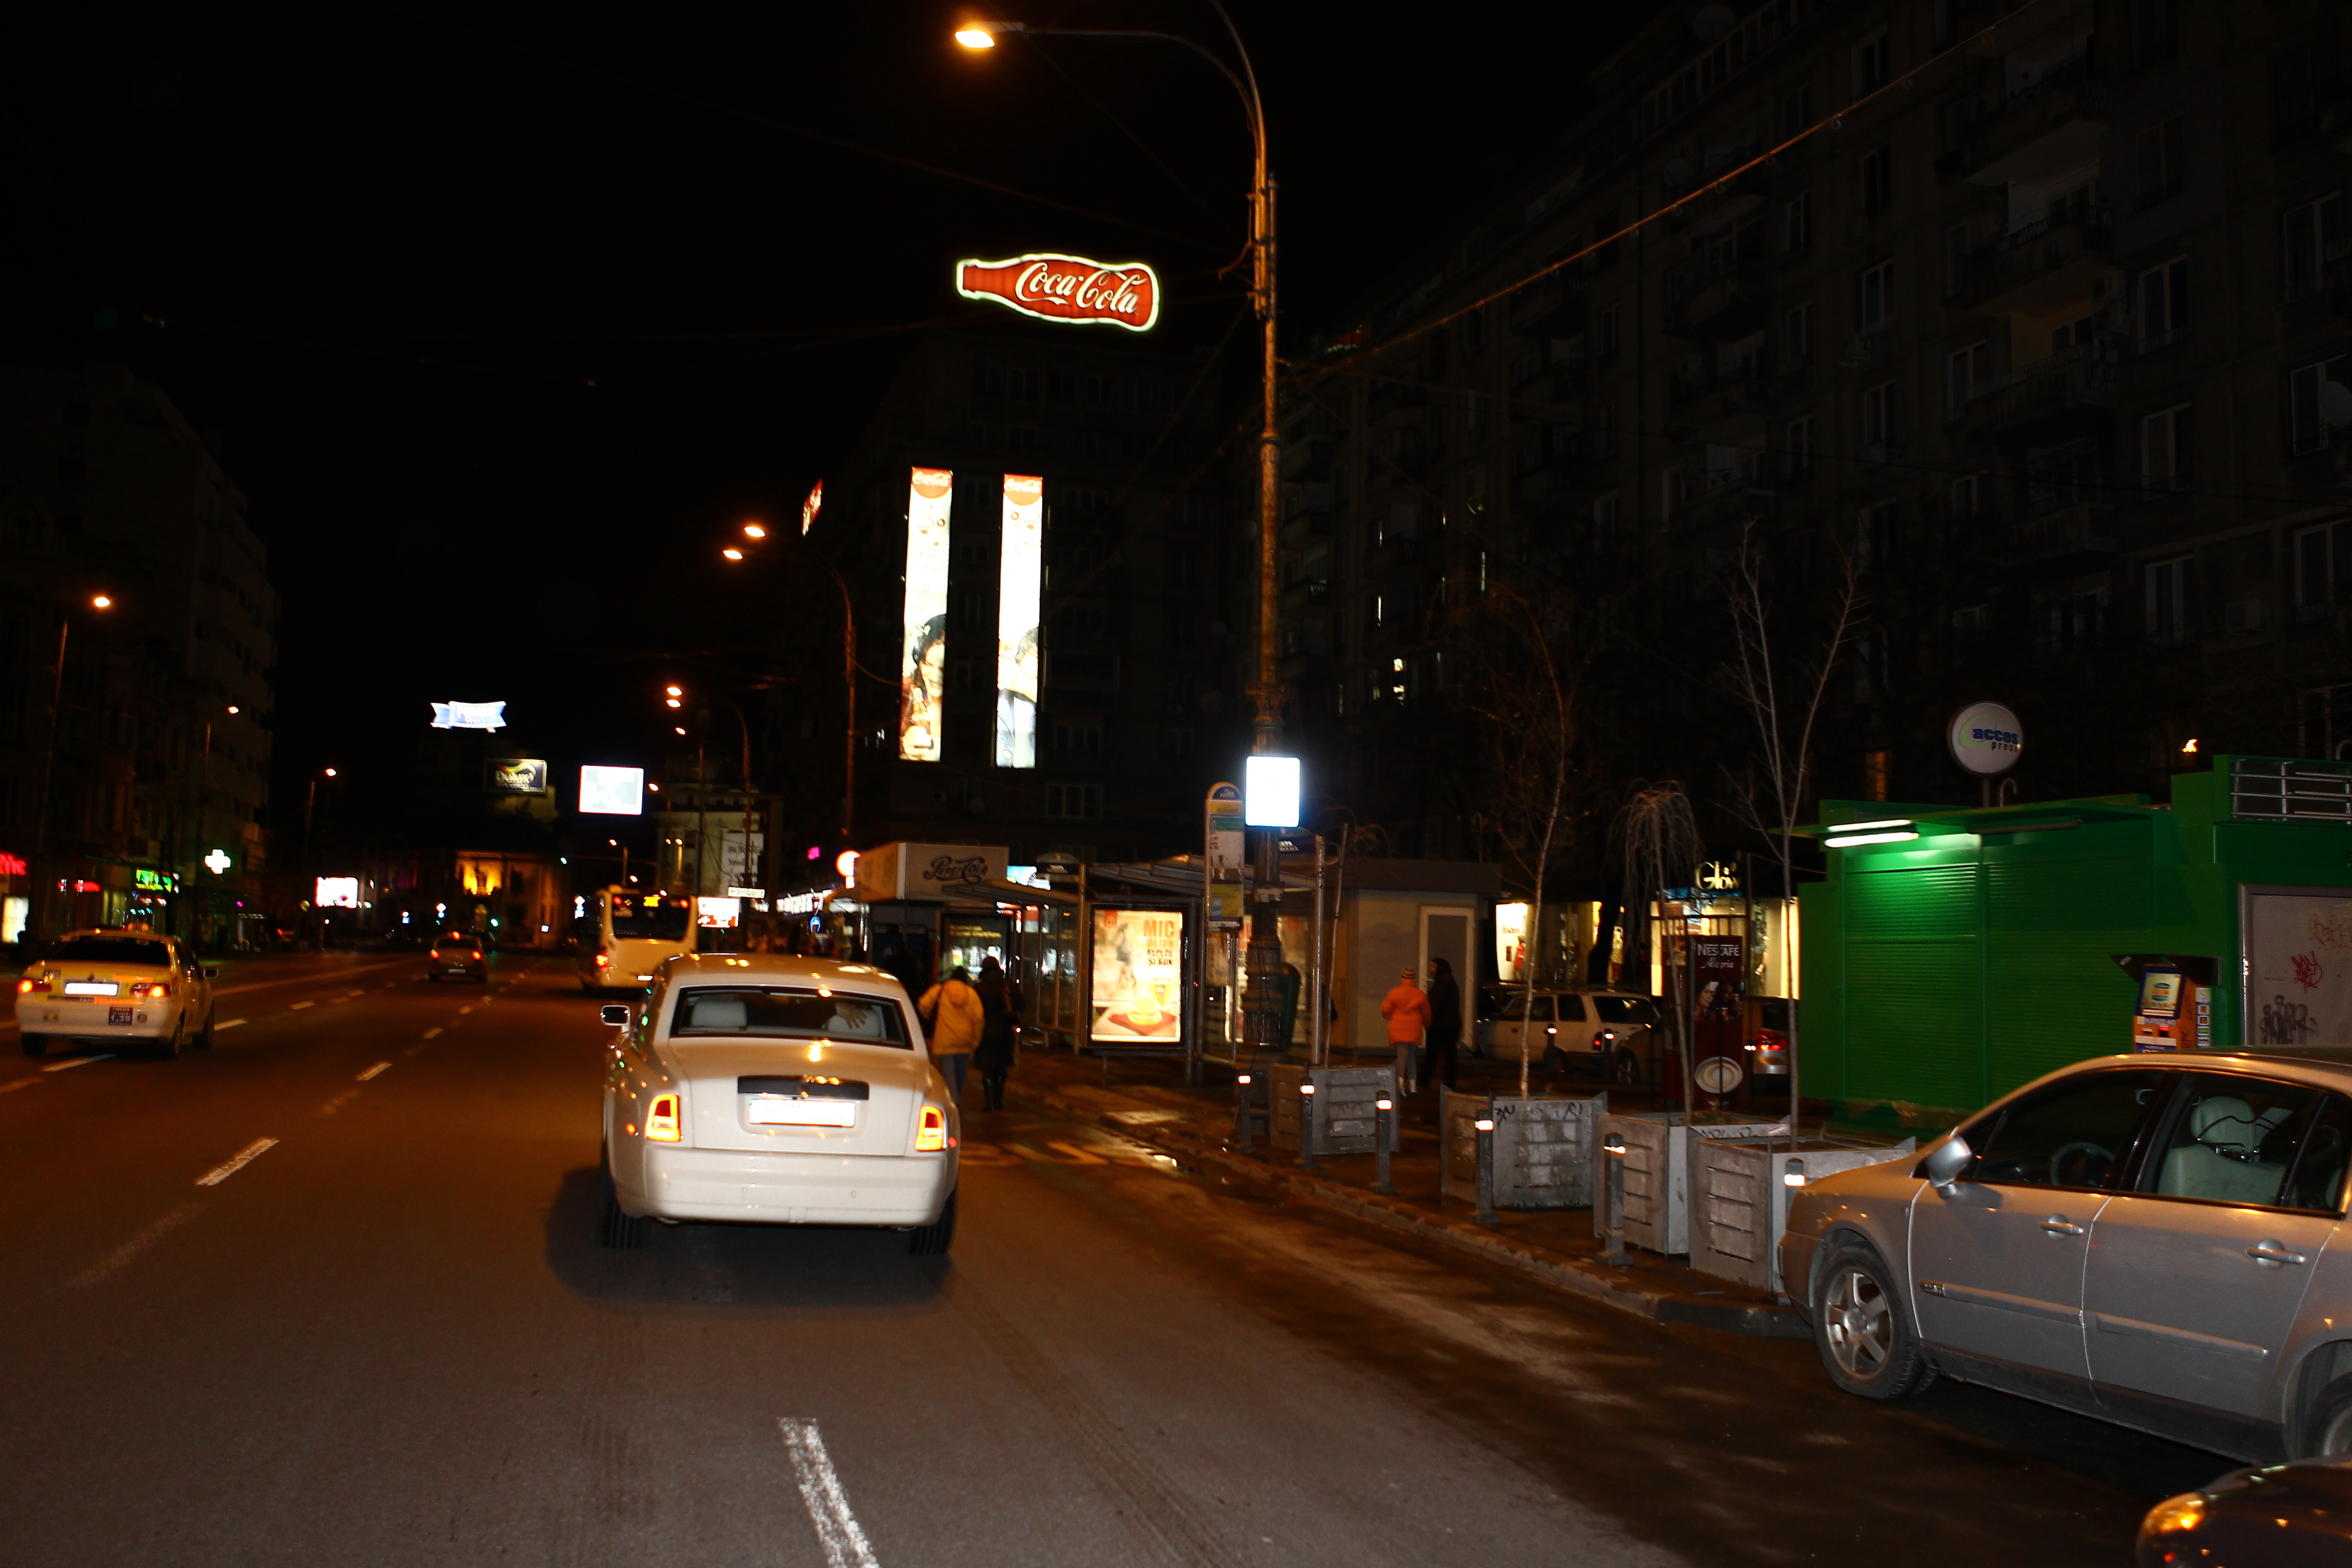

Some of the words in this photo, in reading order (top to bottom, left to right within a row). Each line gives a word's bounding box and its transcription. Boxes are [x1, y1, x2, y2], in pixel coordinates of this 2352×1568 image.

[1015, 262, 1147, 315] Coca-Cola
[1972, 728, 2019, 744] acces
[1143, 919, 1175, 937] MIC
